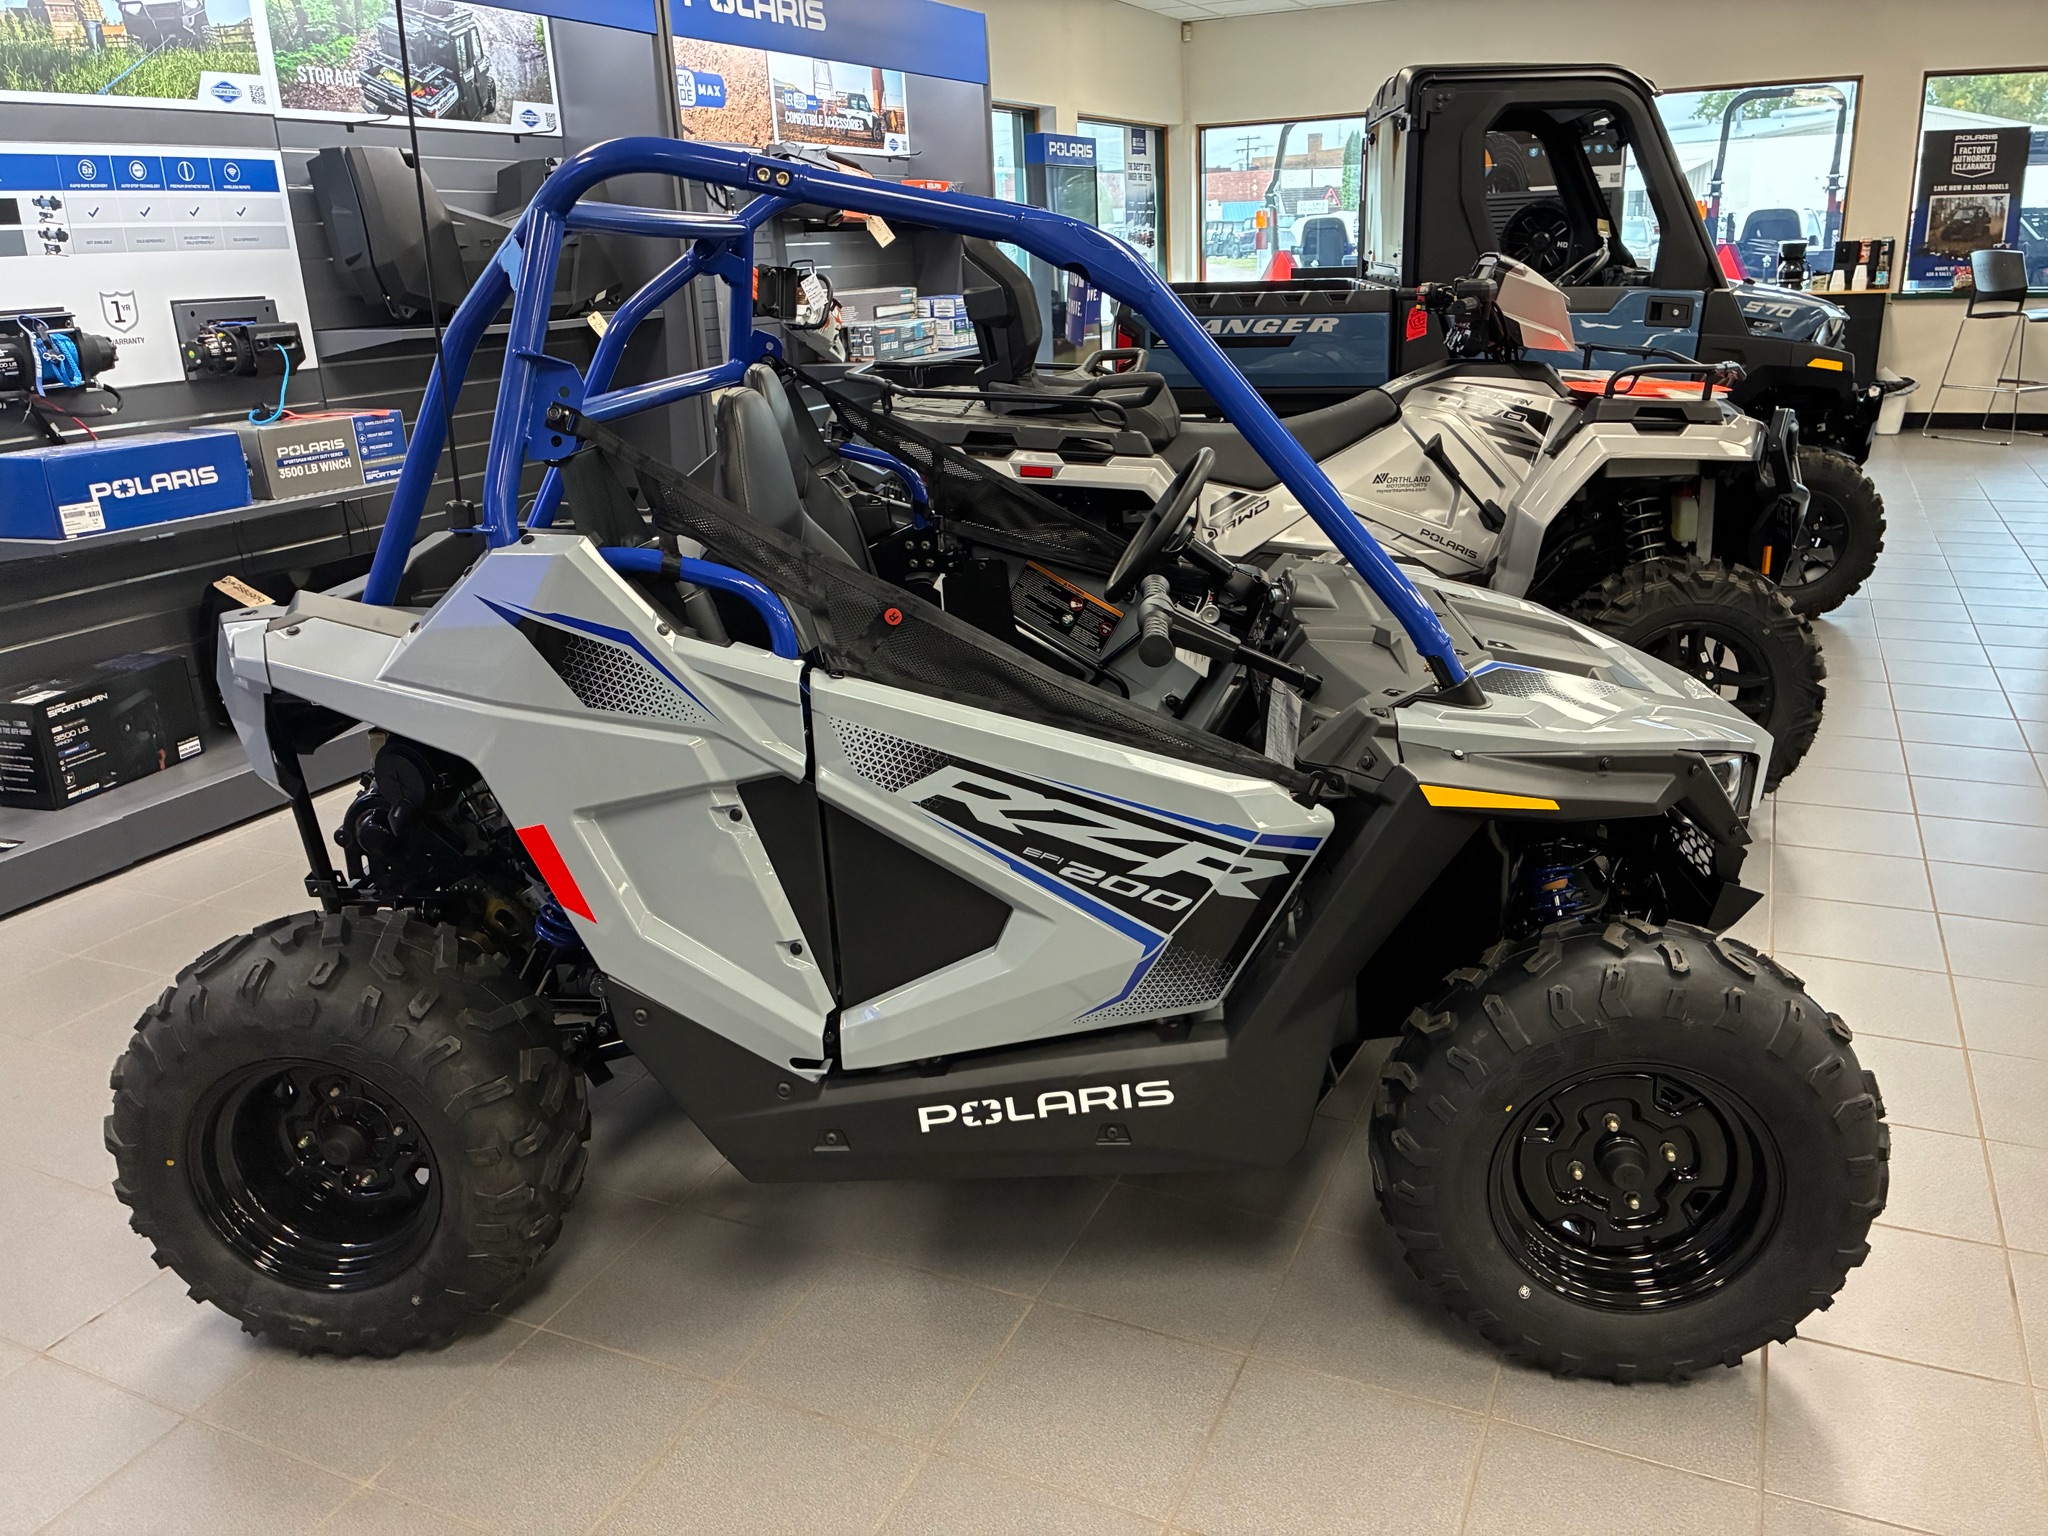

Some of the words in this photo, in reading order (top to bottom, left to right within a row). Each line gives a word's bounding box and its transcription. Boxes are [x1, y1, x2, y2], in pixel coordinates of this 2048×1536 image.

[682, 0, 826, 31] OLARIS
[297, 65, 362, 87] STORAGE
[677, 74, 692, 87] CK
[680, 89, 694, 102] DE
[697, 83, 722, 97] MAX
[784, 111, 824, 127] COMPATIBLE
[824, 116, 864, 131] ACCESSORIES
[1955, 133, 1999, 141] POLARIS
[1048, 141, 1094, 159] POLARIS
[1959, 146, 1992, 154] FACTORY
[1952, 154, 1997, 163] AUTHORIZED
[1955, 162, 1992, 171] CLEARANCE
[1933, 184, 1948, 192] SAVE
[1949, 183, 1962, 191] NOW
[1963, 183, 1972, 191] ON
[1556, 240, 1569, 249] HD
[111, 300, 126, 324] 1
[121, 304, 131, 312] YR
[1203, 317, 1340, 334] ANGER
[1753, 320, 1774, 329] EFI
[276, 438, 346, 459] POLARIS
[278, 465, 304, 479] 3500
[304, 463, 319, 475] LB
[319, 457, 352, 472] WINCH
[283, 457, 307, 465] SPORTSMAN
[88, 465, 219, 502] POLARIS
[1420, 527, 1478, 560] POLARIS
[47, 692, 109, 718] SPORTSMAN
[53, 729, 77, 743] 3500
[55, 738, 73, 747] WINCH
[903, 765, 1291, 900] RZR
[1022, 846, 1064, 867] EFI
[1058, 862, 1193, 912] 200
[917, 1080, 1175, 1133] POLARIS
